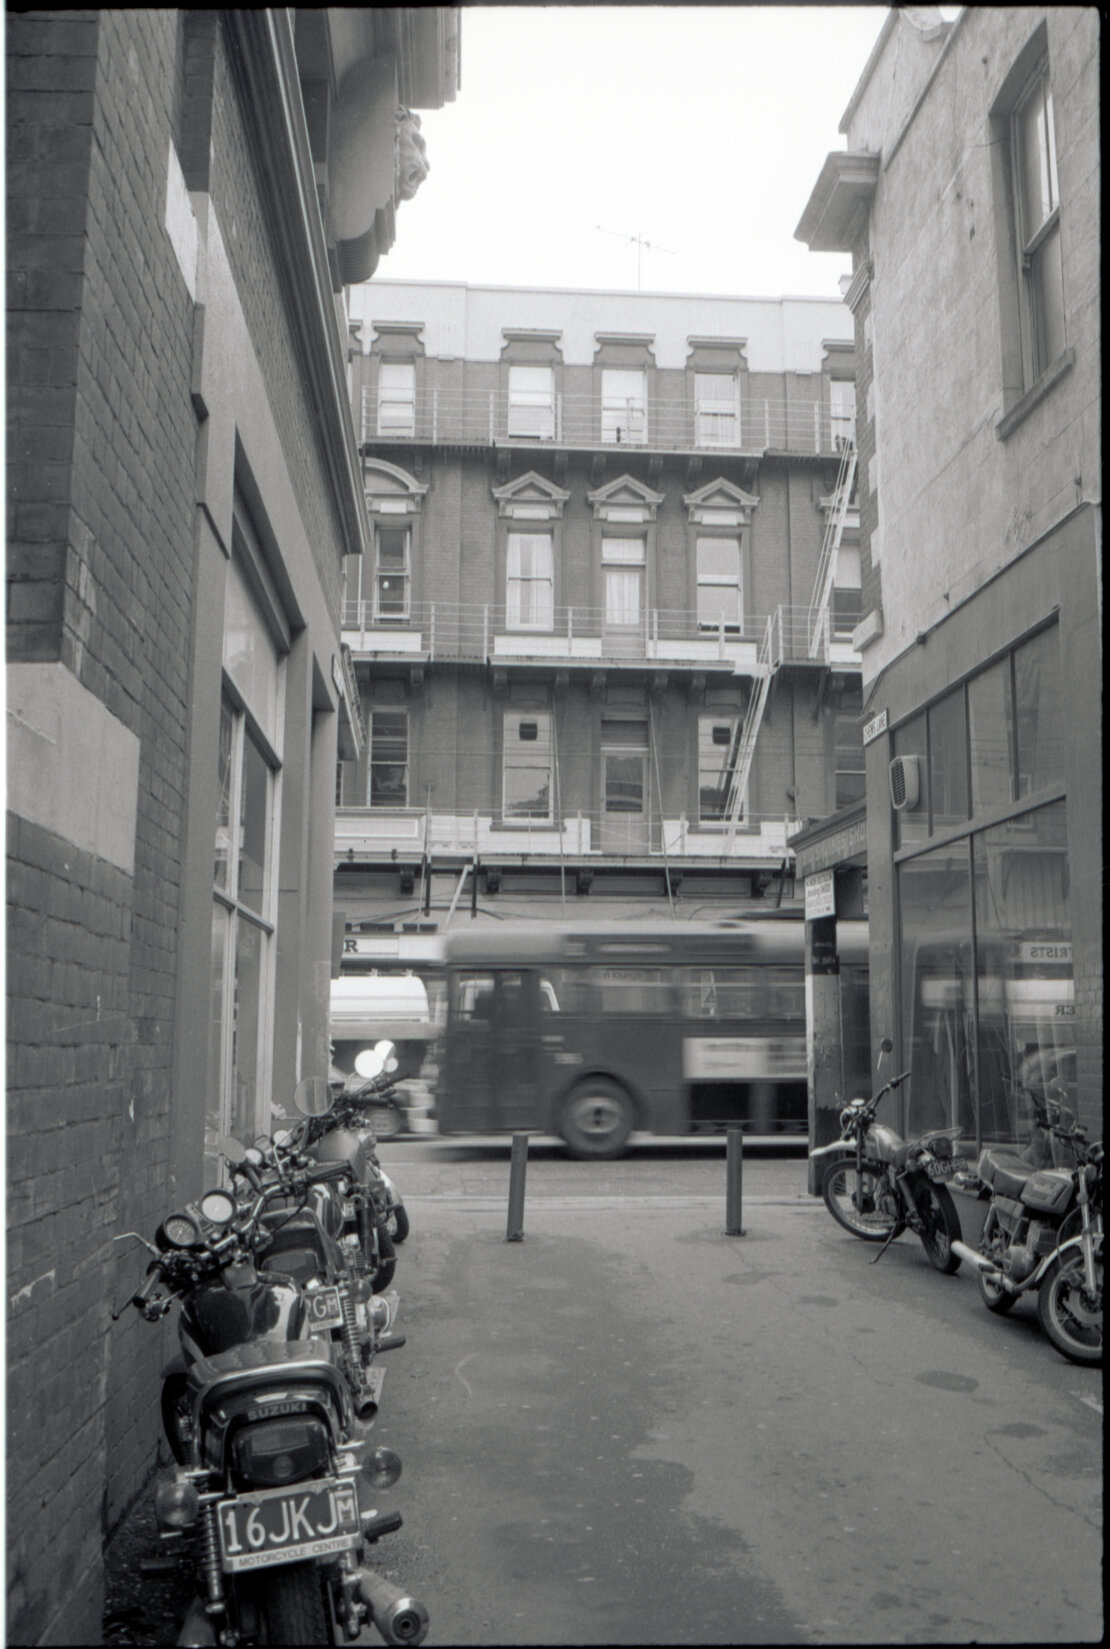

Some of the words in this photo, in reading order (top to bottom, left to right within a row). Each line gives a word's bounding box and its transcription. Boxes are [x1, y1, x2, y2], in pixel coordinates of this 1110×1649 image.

[877, 711, 886, 732] LANE
[849, 823, 866, 847] SHO
[247, 1402, 308, 1421] SUZUKI
[238, 1547, 307, 1568] MOTORCYCLE
[312, 1538, 351, 1554] CENTRE
